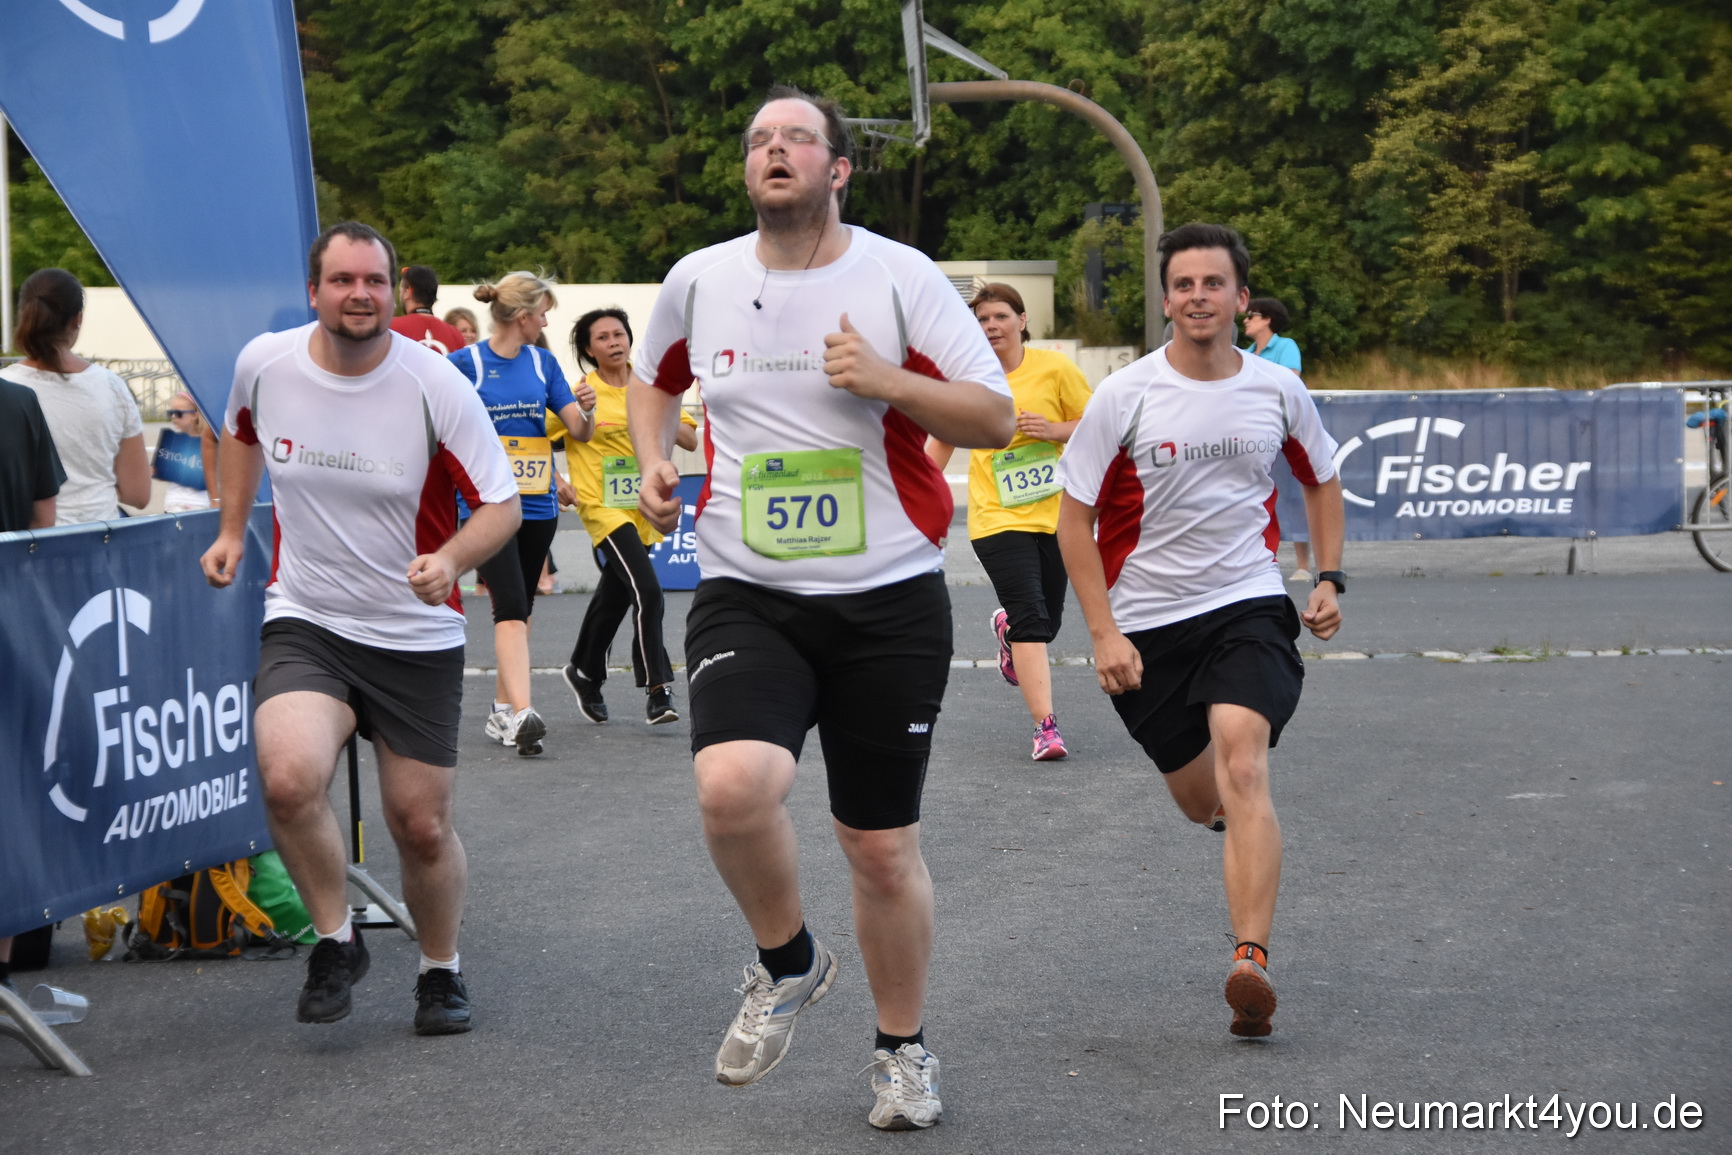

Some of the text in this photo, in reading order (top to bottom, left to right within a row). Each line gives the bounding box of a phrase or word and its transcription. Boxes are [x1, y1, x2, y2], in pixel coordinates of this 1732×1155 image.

[485, 403, 517, 411] endwann
[298, 445, 404, 477] intellitools
[1184, 434, 1276, 461] intellitools
[1002, 464, 1055, 492] 1332
[1376, 453, 1592, 495] Fischer
[766, 493, 839, 530] 570
[1395, 498, 1574, 518] AUTOMOBILE
[776, 535, 832, 545] Matthias Rajzer
[103, 767, 248, 844] AUTOMOBILE
